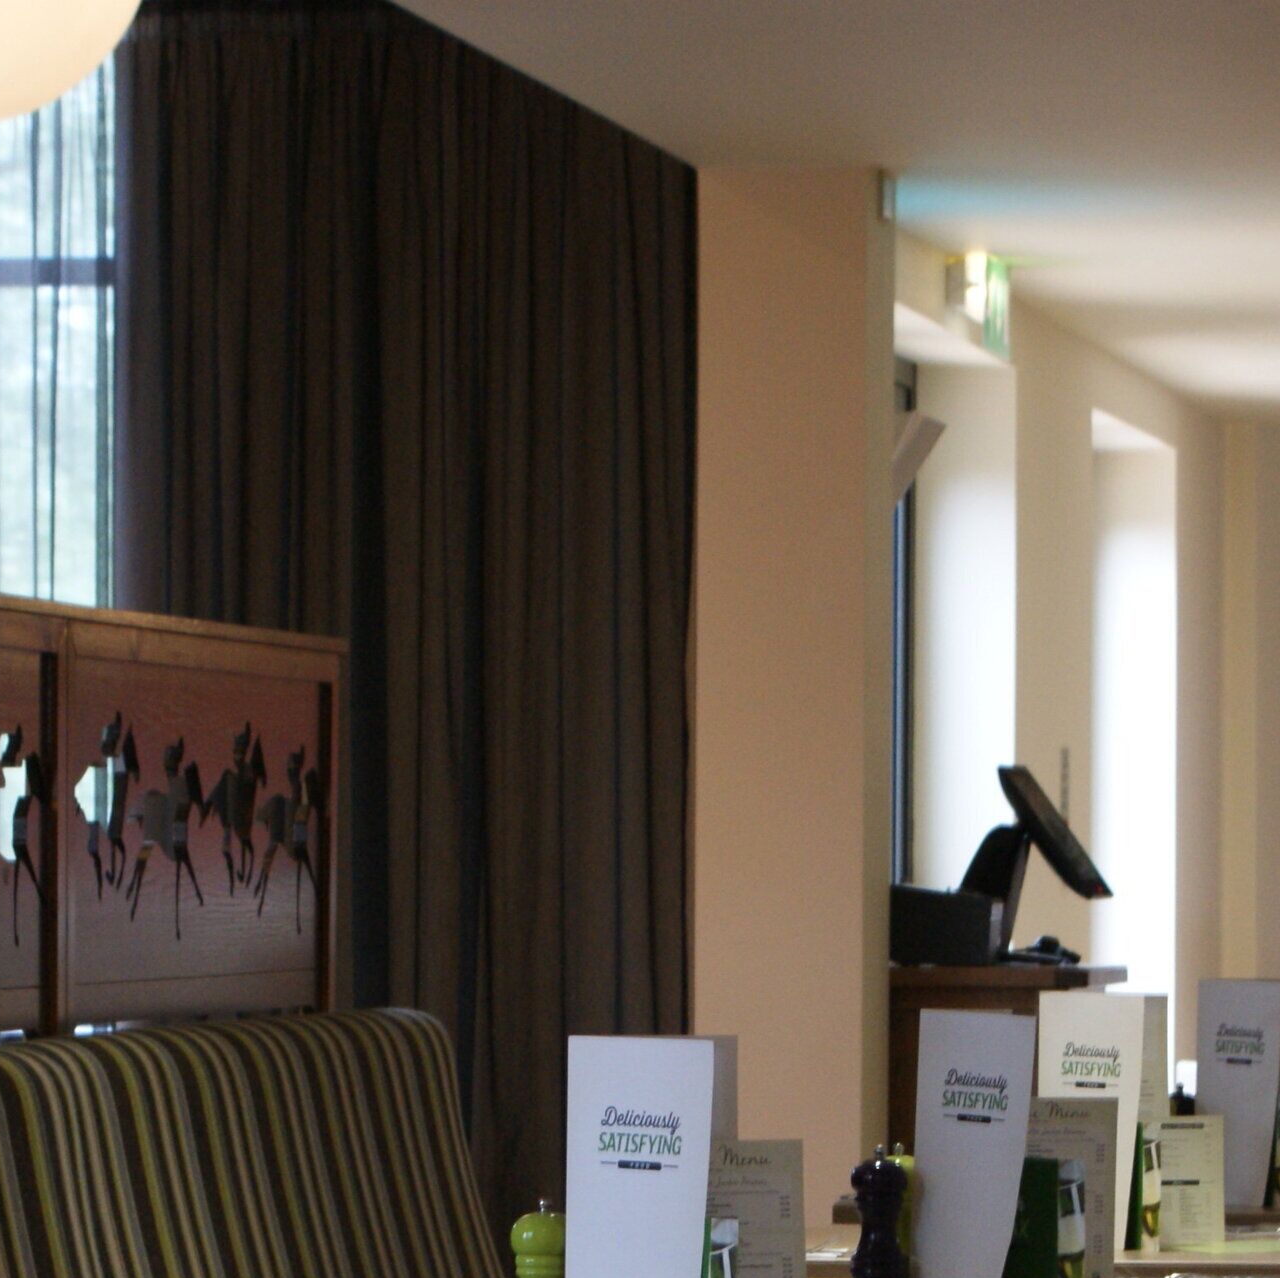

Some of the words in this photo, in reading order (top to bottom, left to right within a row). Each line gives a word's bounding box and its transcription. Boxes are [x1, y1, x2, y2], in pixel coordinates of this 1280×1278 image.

[1063, 1042, 1119, 1065] Deliciously
[1061, 1061, 1121, 1077] SATISFYING
[945, 1068, 1007, 1094] Deliciously
[943, 1090, 1008, 1110] SATISFYING
[601, 1106, 680, 1135] Deliciously
[598, 1132, 681, 1155] SATISFYING
[718, 1144, 771, 1168] Menu
